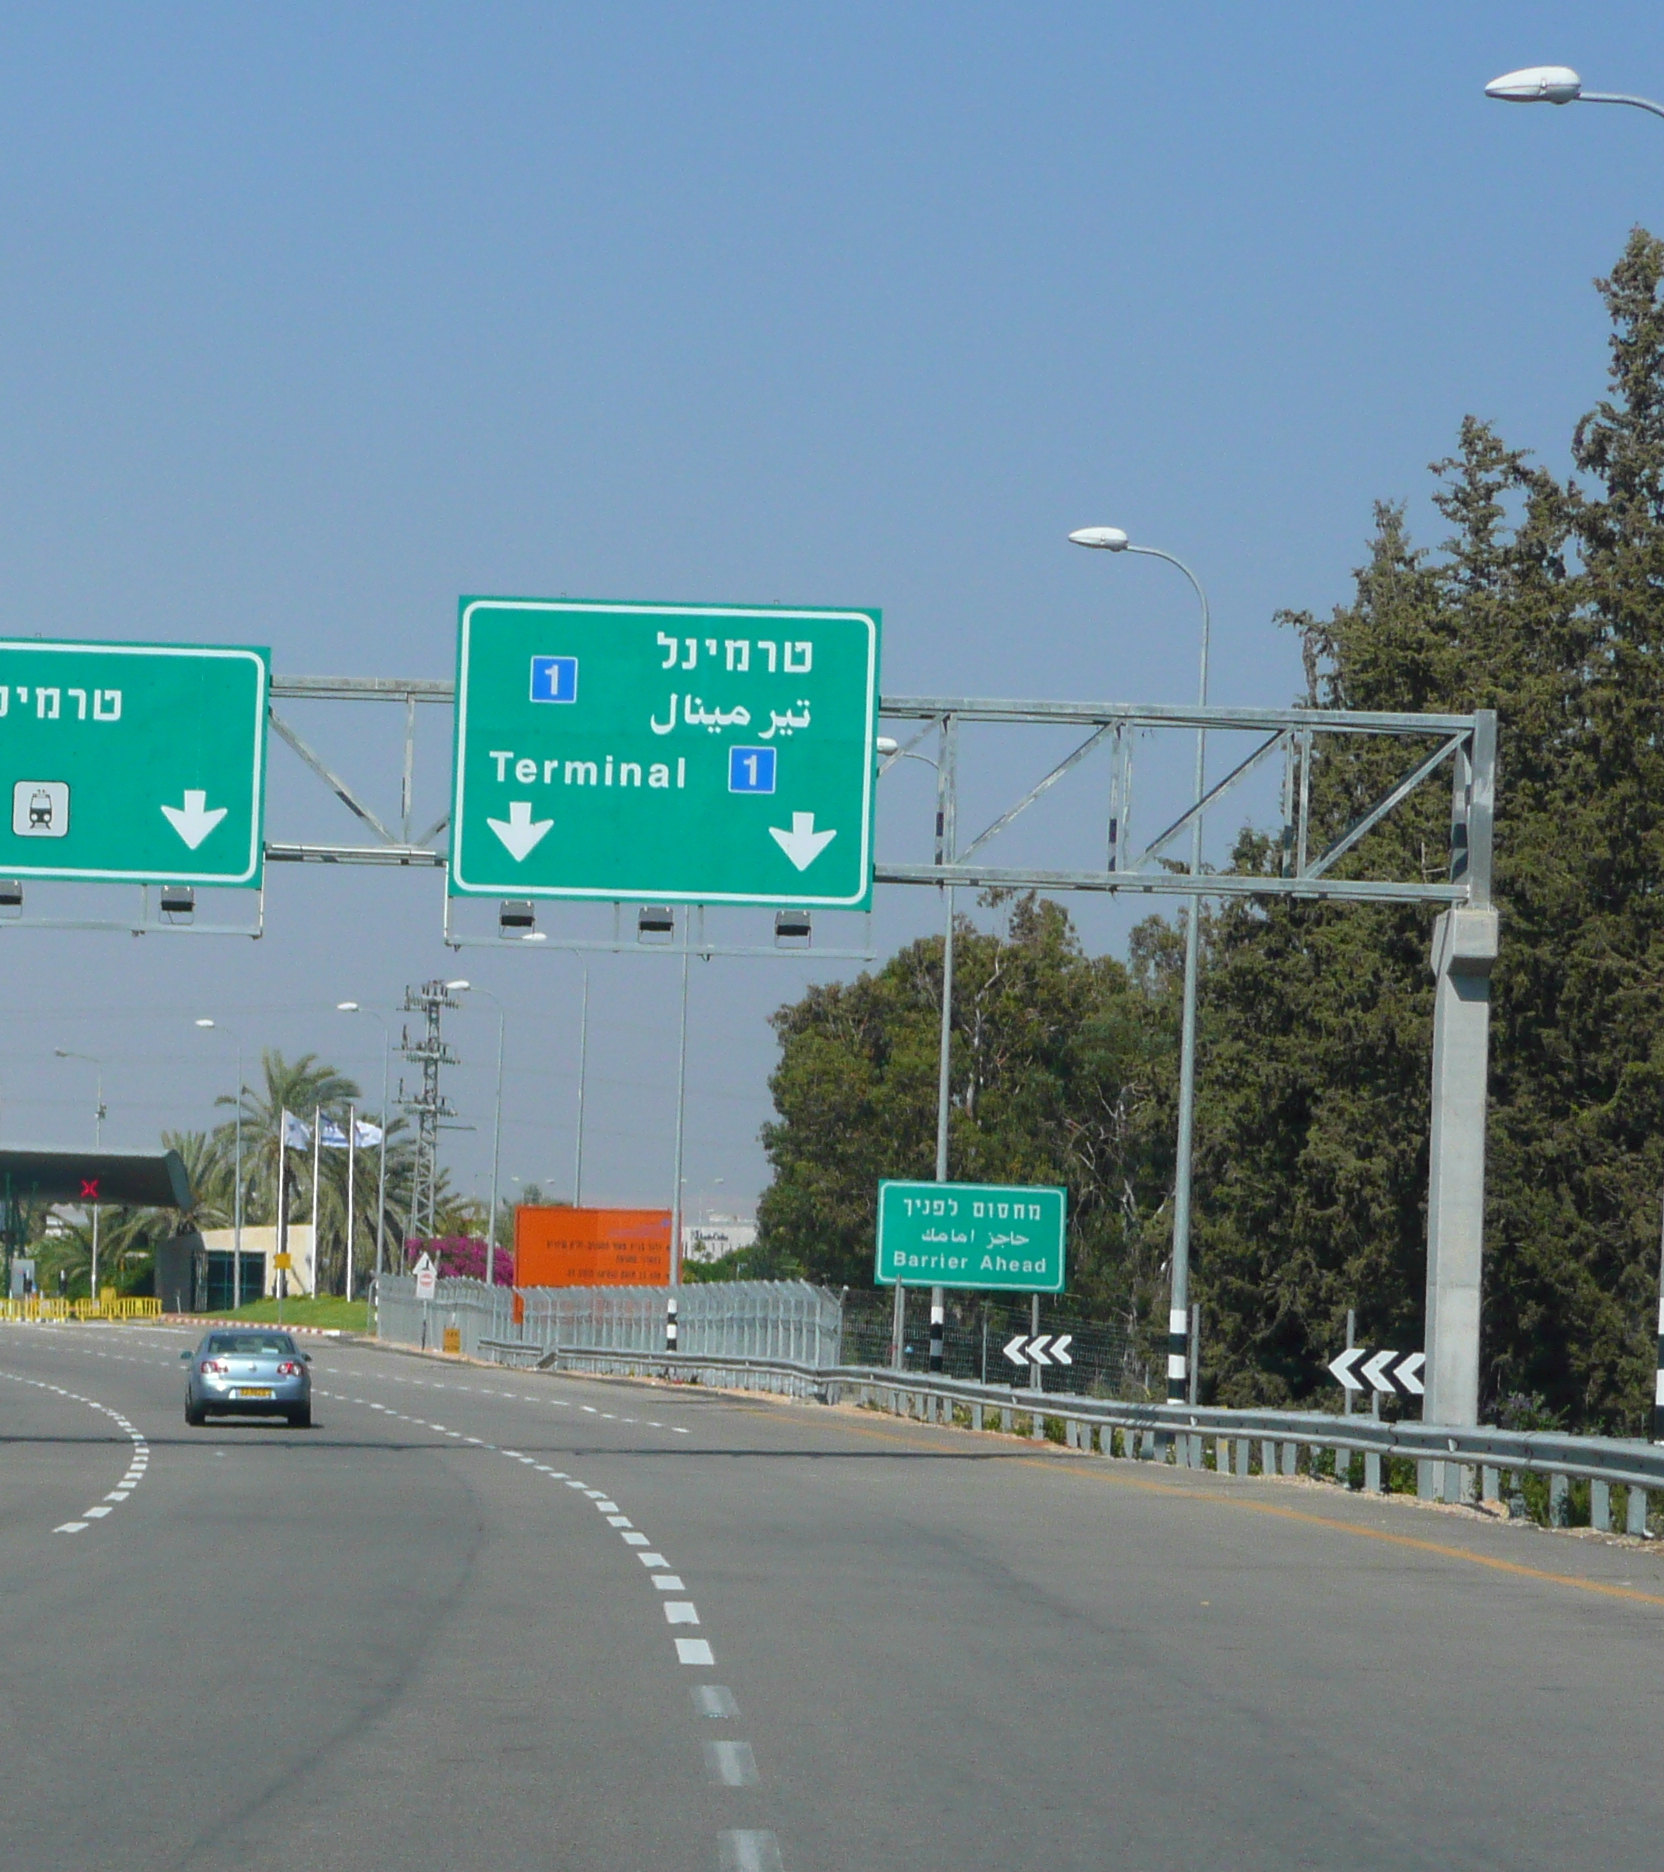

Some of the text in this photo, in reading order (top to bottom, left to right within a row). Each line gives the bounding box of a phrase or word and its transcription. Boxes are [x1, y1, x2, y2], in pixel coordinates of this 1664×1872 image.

[656, 630, 813, 674] טרמינל
[544, 663, 560, 696] 1
[489, 750, 758, 789] Terminal 1
[903, 1198, 1041, 1221] מחסום לפניך
[986, 1231, 1030, 1249] حاجز
[893, 1250, 1047, 1273] Barrier Ahead
